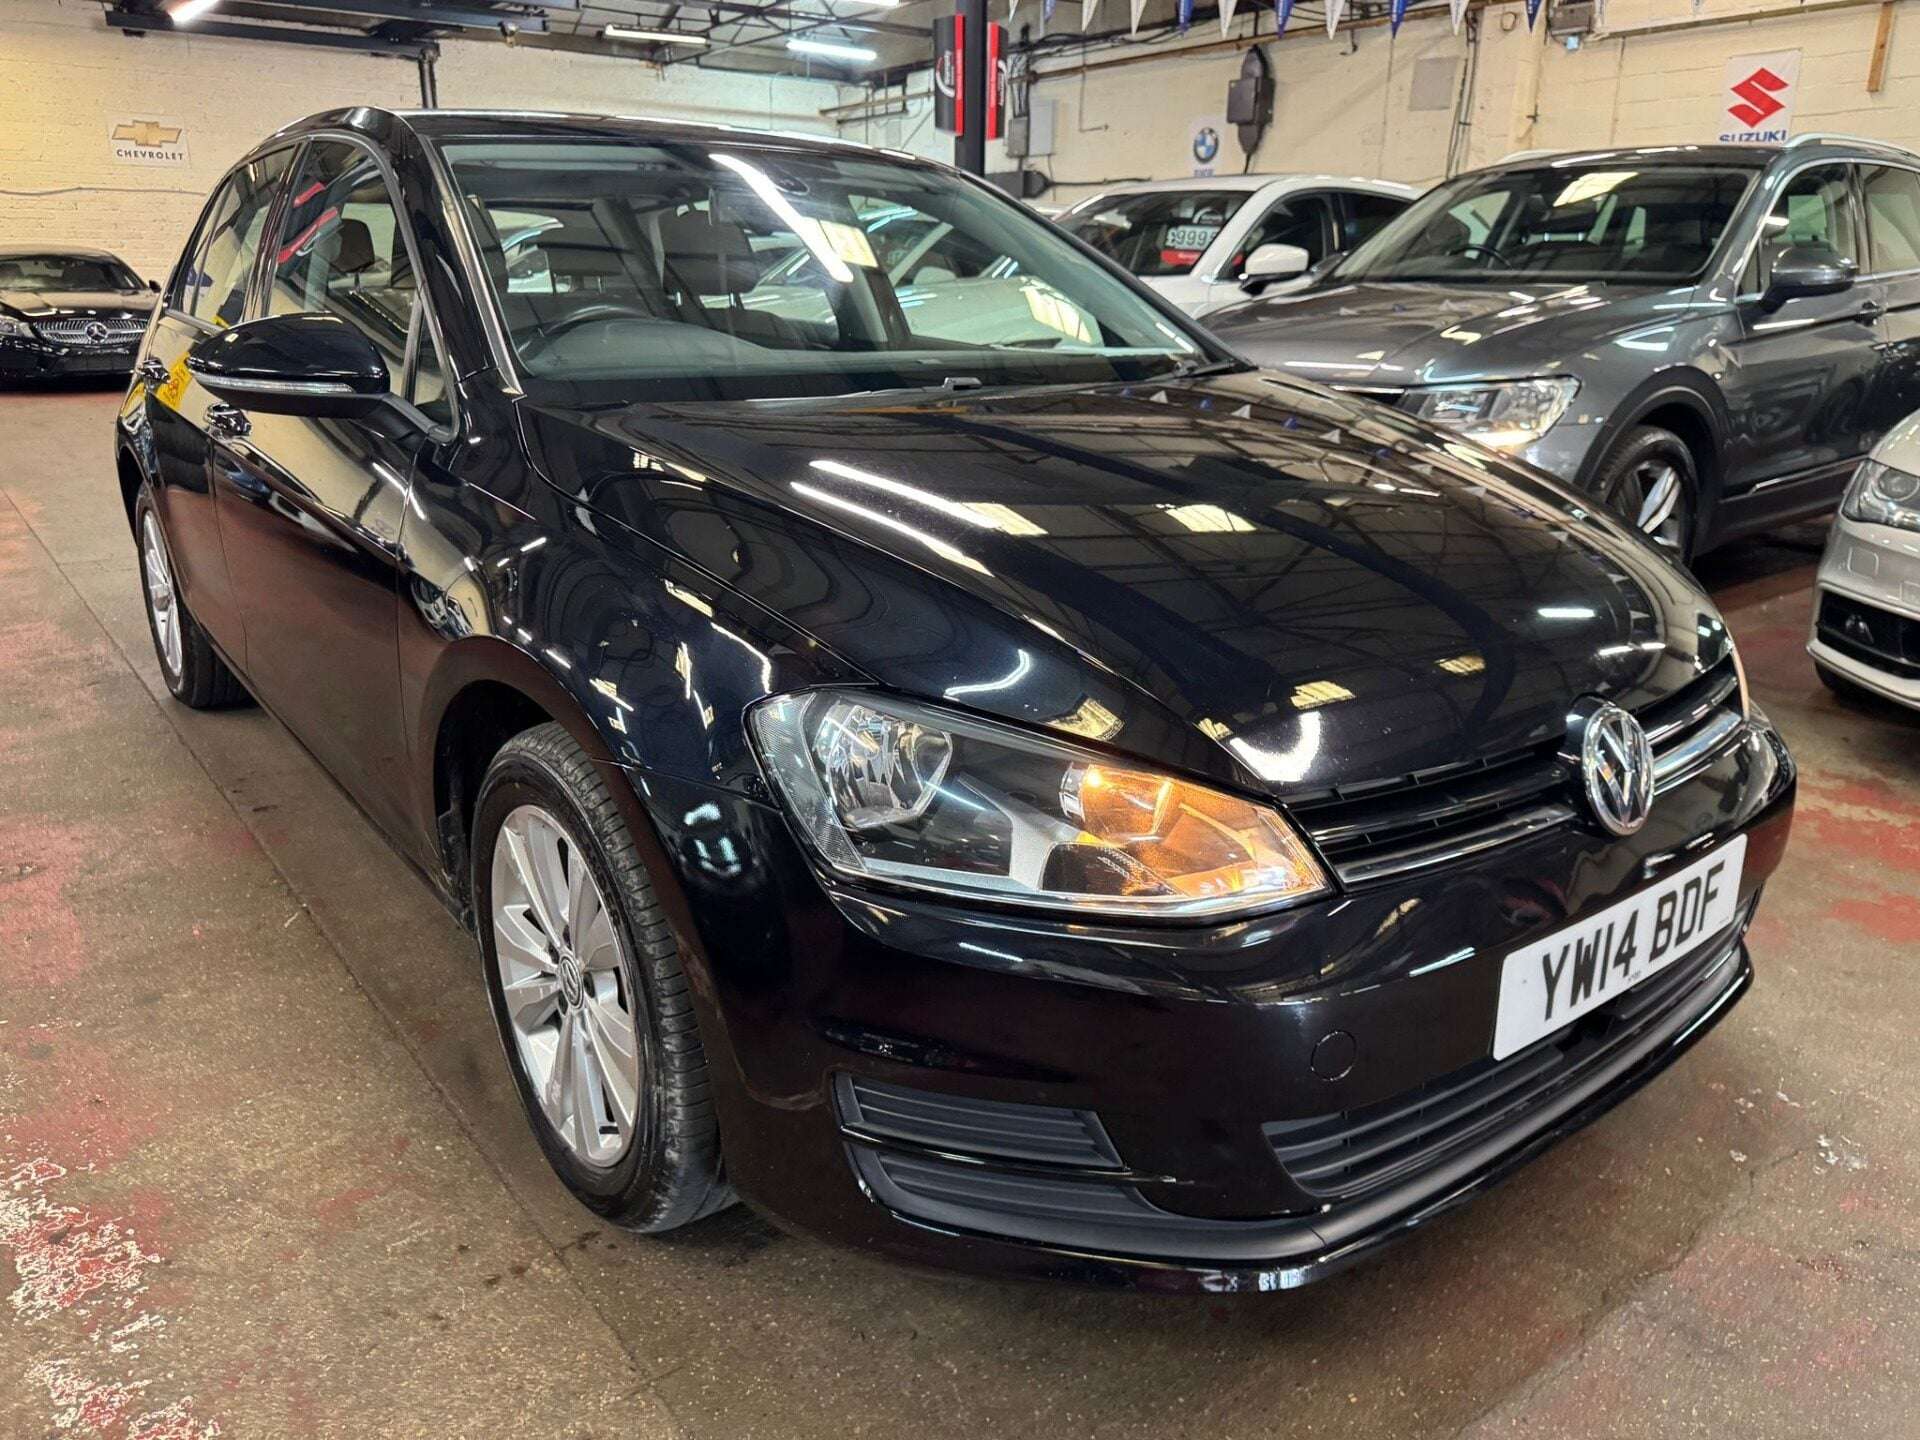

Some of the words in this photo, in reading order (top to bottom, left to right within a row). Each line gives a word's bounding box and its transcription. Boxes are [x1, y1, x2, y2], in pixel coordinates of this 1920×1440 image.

[116, 149, 184, 160] CHEVROLET
[1542, 909, 1639, 1022] YW14
[1649, 860, 1726, 964] BDF
